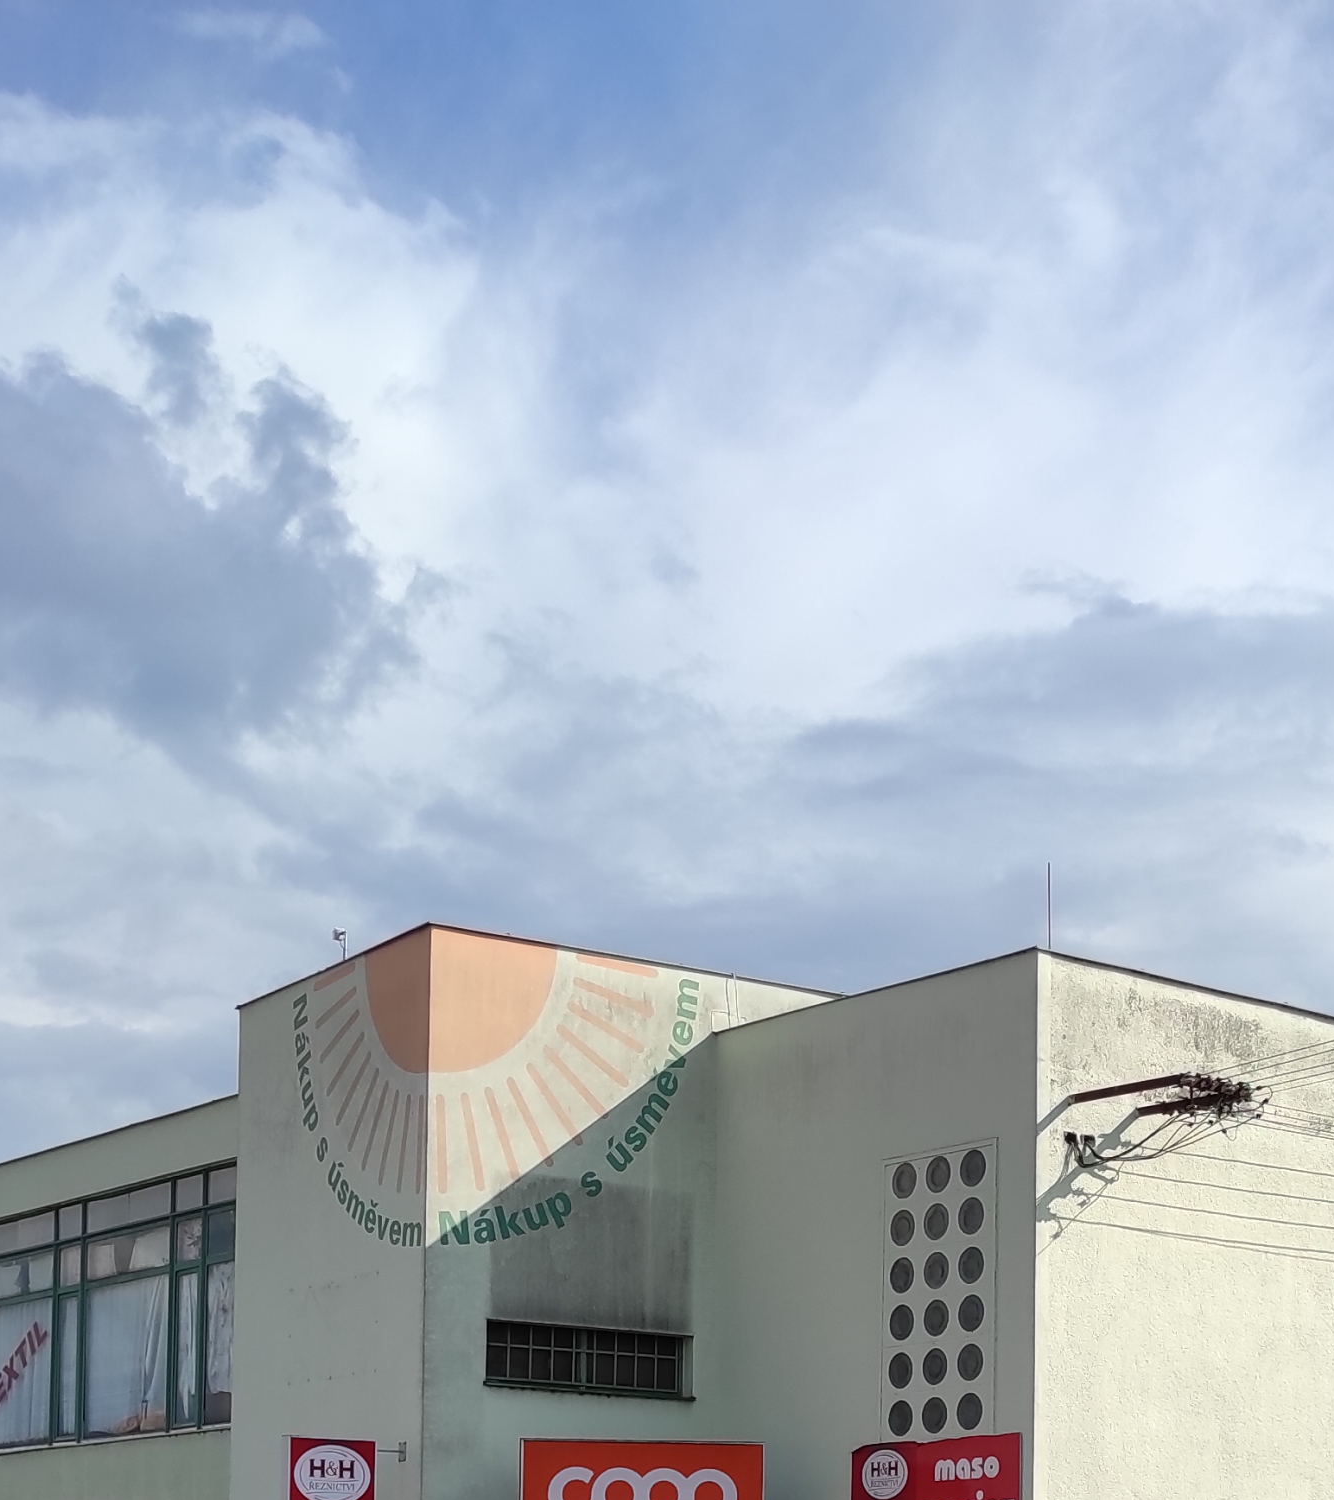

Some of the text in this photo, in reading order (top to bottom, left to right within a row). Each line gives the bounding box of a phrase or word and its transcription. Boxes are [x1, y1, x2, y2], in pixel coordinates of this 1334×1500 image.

[292, 992, 422, 1247] Nákup s úsměvem
[437, 978, 700, 1246] Nákup s úsměvem
[309, 1459, 355, 1479] H&H
[871, 1460, 898, 1478] H&H
[934, 1455, 1000, 1482] maso
